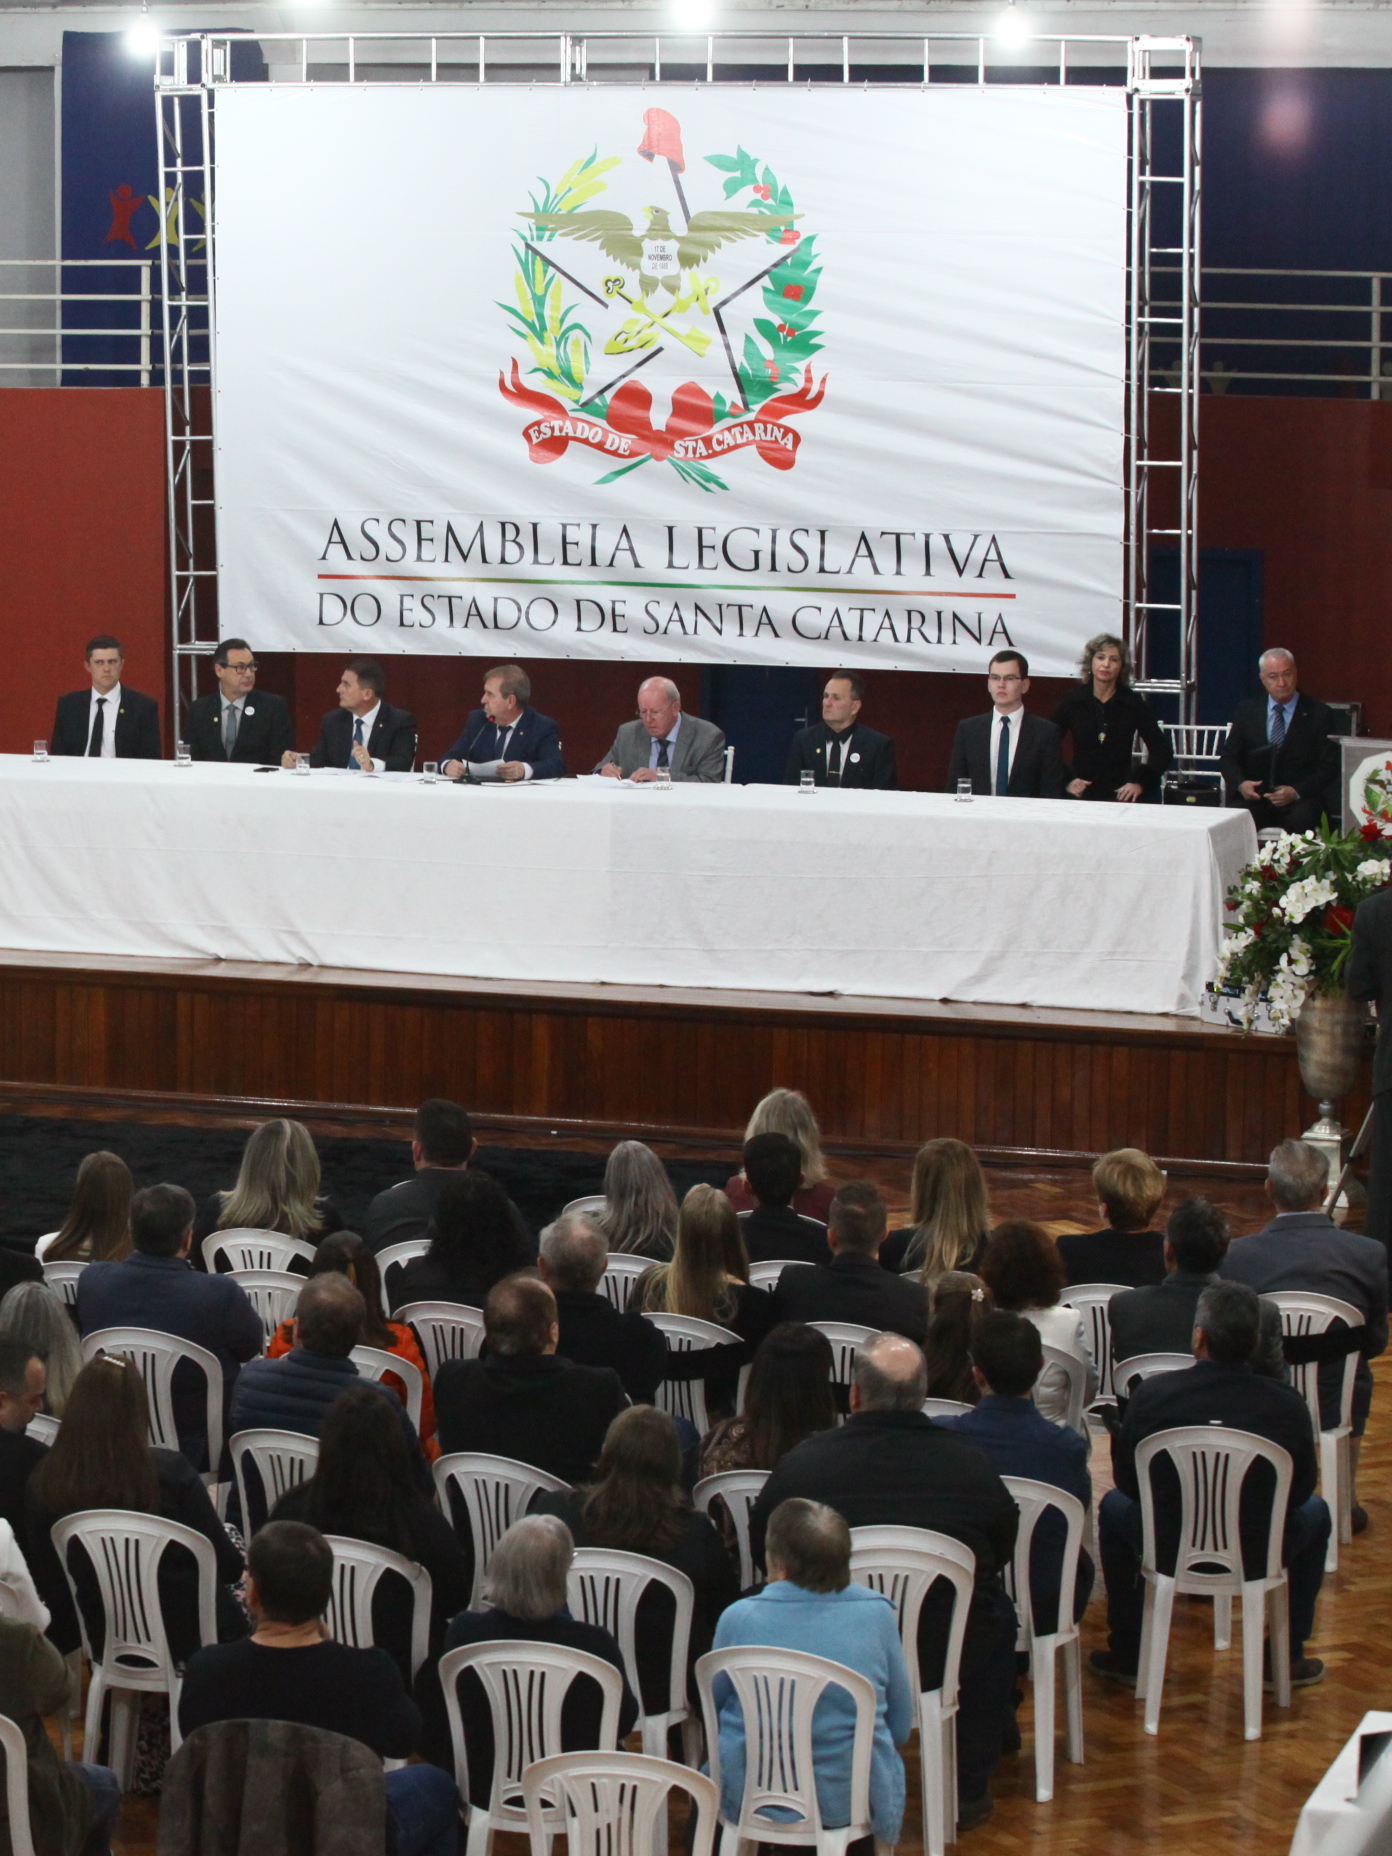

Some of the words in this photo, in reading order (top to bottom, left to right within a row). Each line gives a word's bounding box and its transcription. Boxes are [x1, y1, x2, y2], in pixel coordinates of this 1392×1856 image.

[528, 420, 602, 444] ESTADO
[604, 433, 631, 455] DE
[673, 439, 712, 457] STA.
[712, 422, 793, 450] CATARINA
[317, 517, 644, 568] ASSEMBLEIA
[663, 525, 1016, 580] LEGISLATIVA
[316, 592, 382, 627] DO
[397, 593, 559, 631] ESTADO
[574, 598, 629, 633] DE
[643, 599, 783, 638] SANTA
[791, 605, 1017, 647] CATARINA
